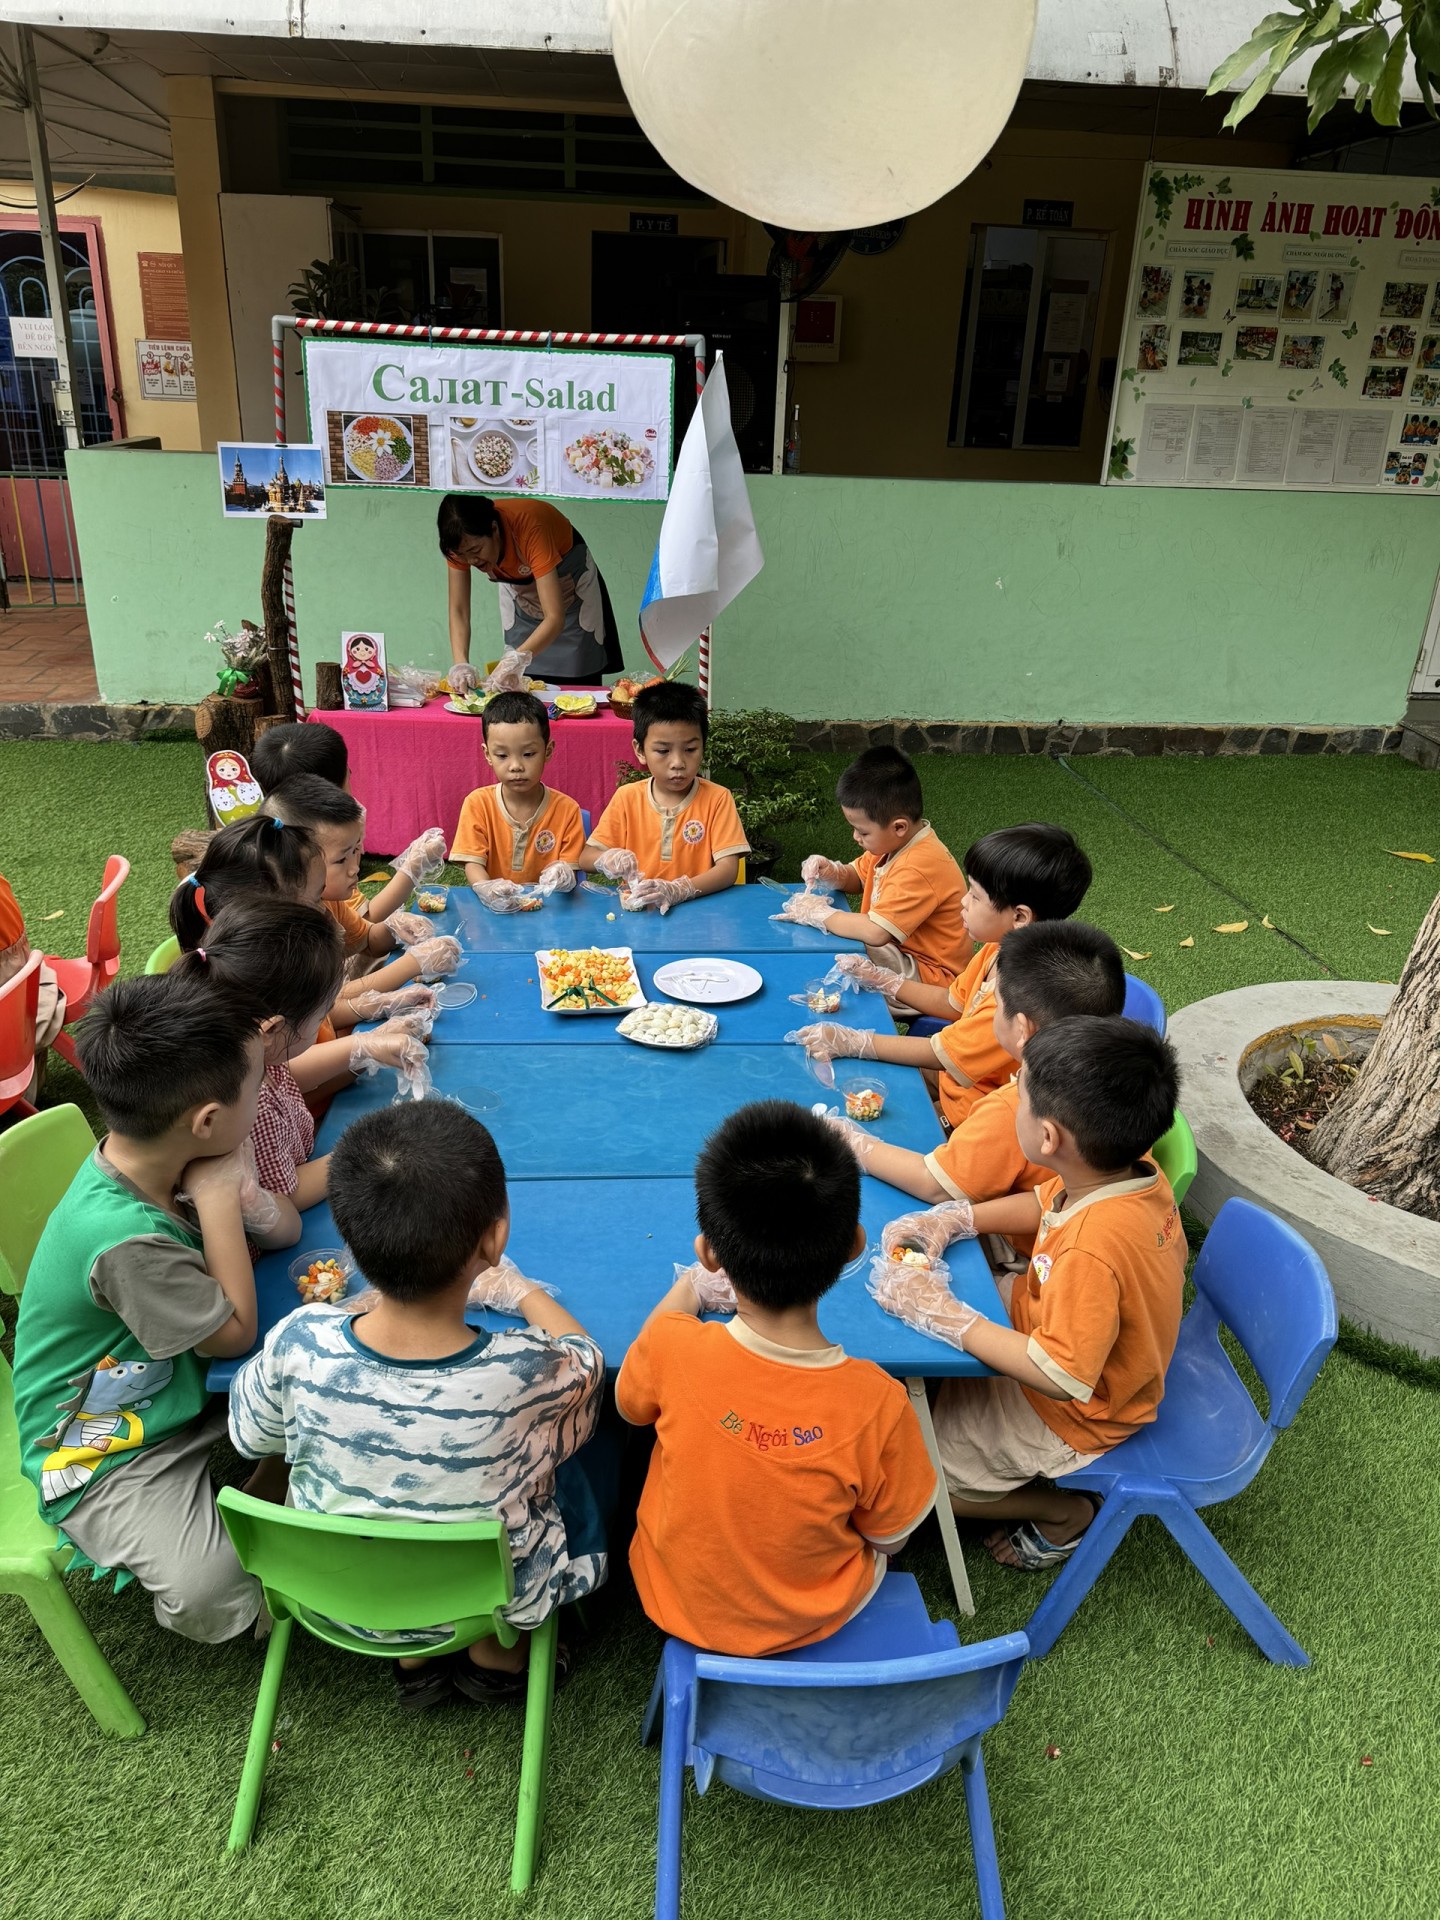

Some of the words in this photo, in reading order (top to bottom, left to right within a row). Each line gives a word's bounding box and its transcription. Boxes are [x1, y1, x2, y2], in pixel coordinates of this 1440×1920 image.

[1184, 192, 1253, 231] HÌNH
[1260, 191, 1314, 234] ẢNH
[1322, 205, 1387, 244] HOẠT
[18, 323, 33, 331] VUI
[720, 1409, 745, 1435] Bé
[745, 1421, 788, 1452] Ngôi
[793, 1425, 823, 1446] Sao
